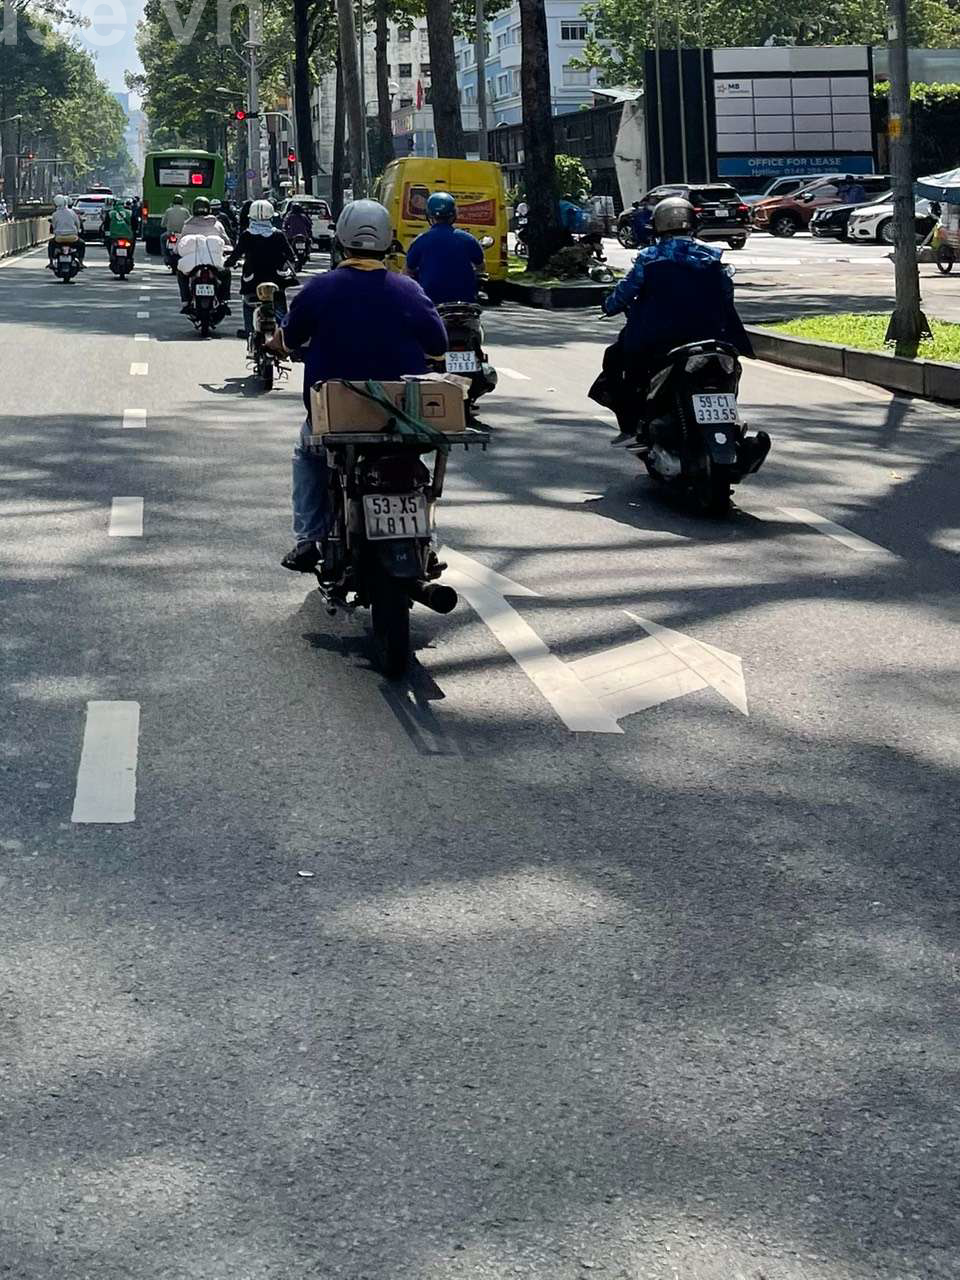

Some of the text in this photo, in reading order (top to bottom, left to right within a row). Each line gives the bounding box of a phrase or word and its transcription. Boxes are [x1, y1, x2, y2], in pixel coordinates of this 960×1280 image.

[748, 157, 842, 168] OFFICE FOR LEASE
[699, 395, 729, 409] 59-C1
[372, 496, 418, 515] 53-X5
